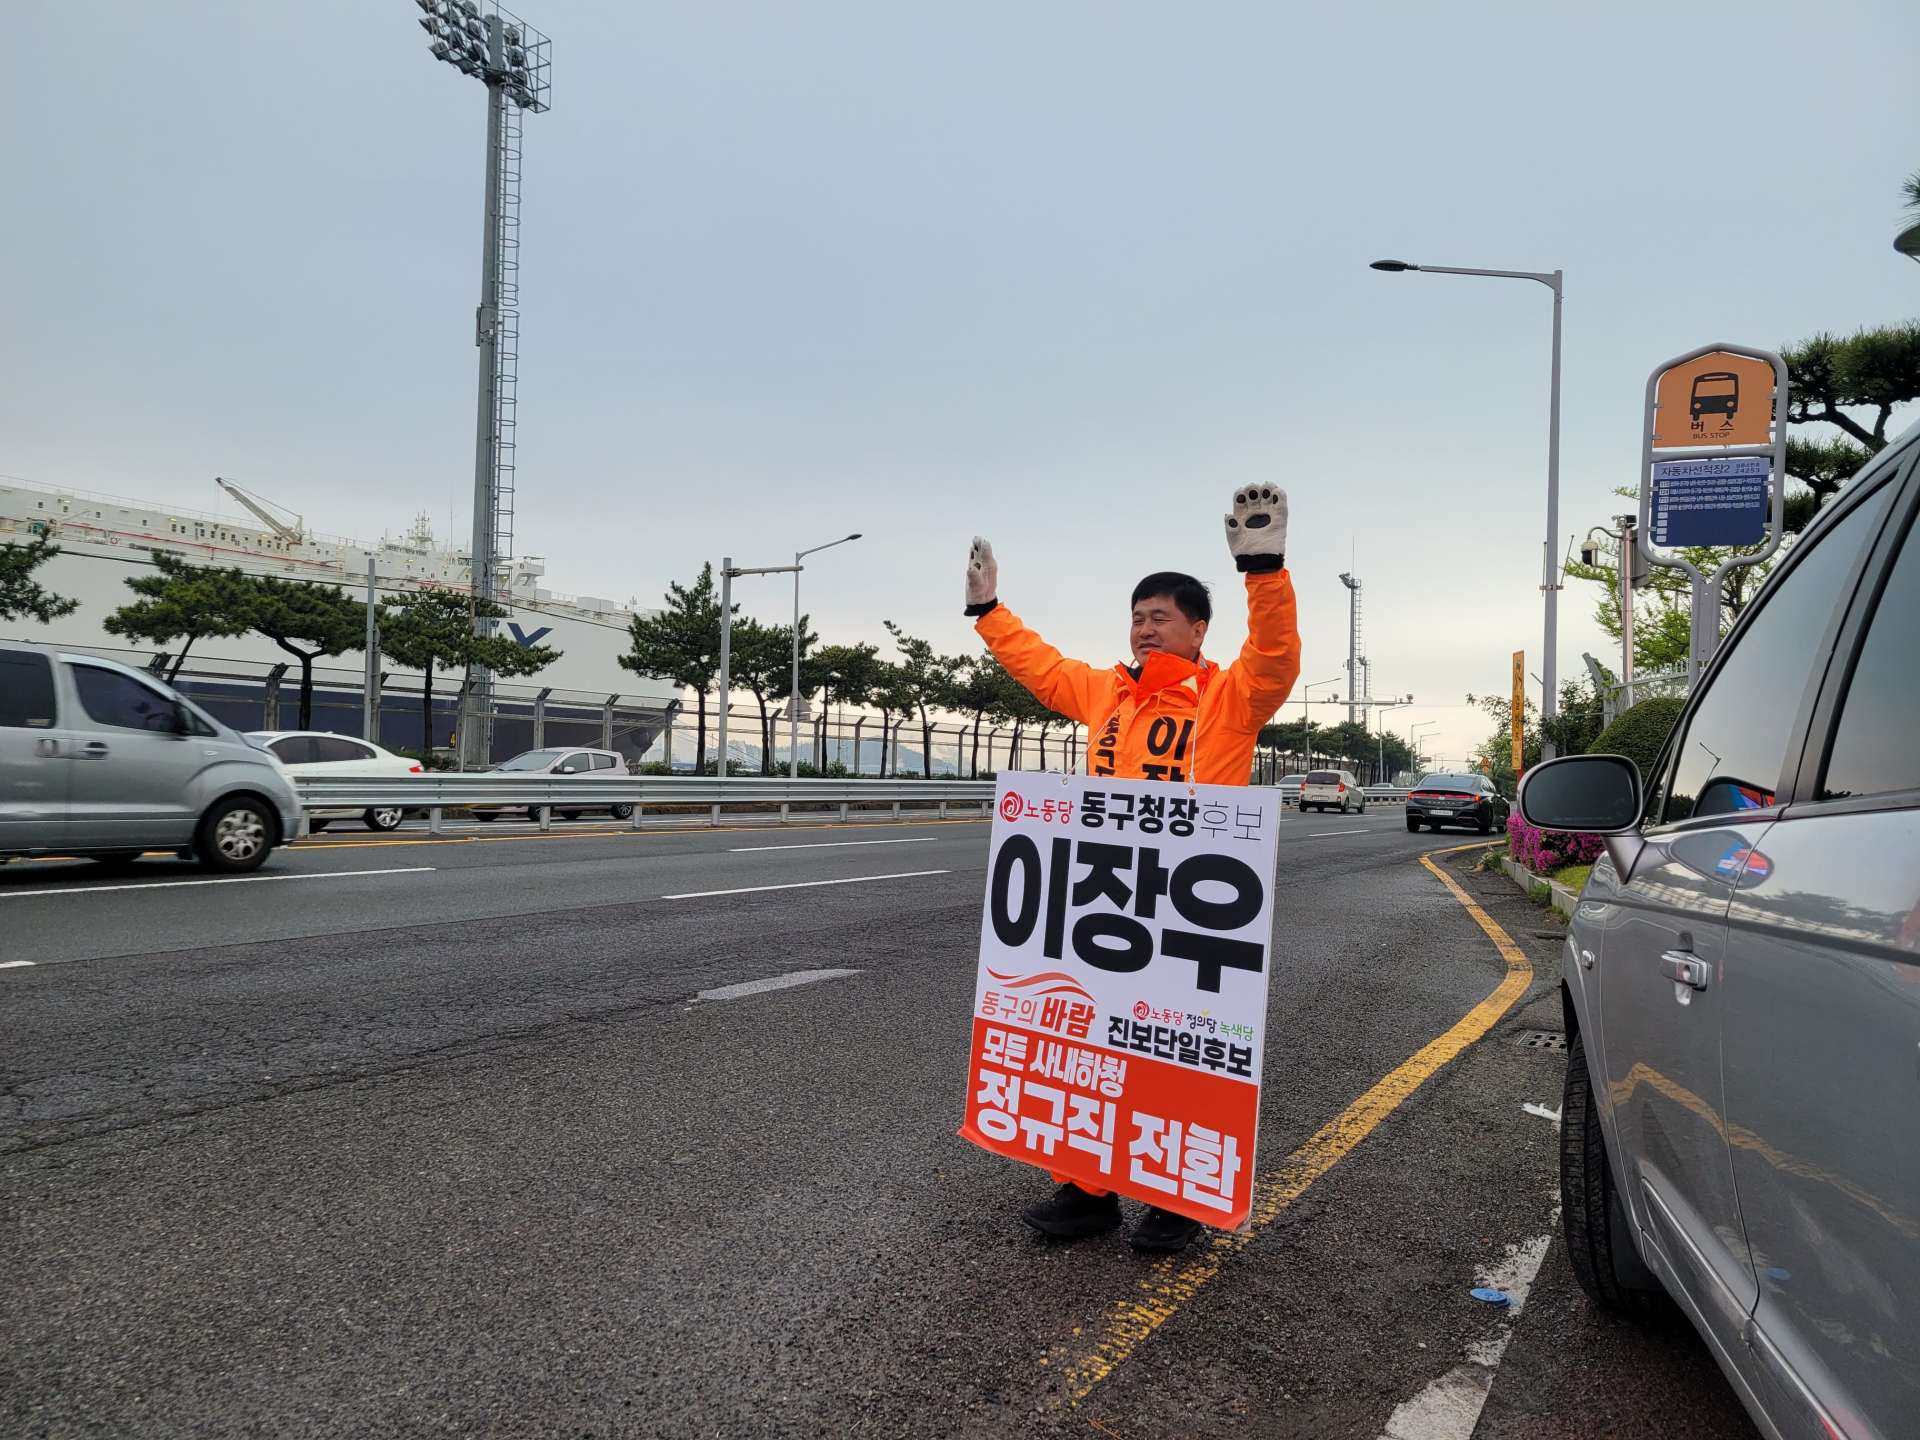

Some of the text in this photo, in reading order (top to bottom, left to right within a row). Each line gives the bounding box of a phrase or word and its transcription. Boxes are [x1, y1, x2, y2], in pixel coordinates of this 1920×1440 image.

[1709, 431, 1730, 439] STOP
[1024, 790, 1262, 841] 노동당 동구청장 후보
[990, 833, 1264, 993] 이장우
[981, 991, 1096, 1039] 동구의 바람
[1150, 1008, 1255, 1042] 노동당 정의당 녹색당
[981, 1027, 1128, 1099] 모든 사내하청
[1108, 1015, 1252, 1078] 진보단일후보
[976, 1068, 1242, 1214] 정규직 전환
